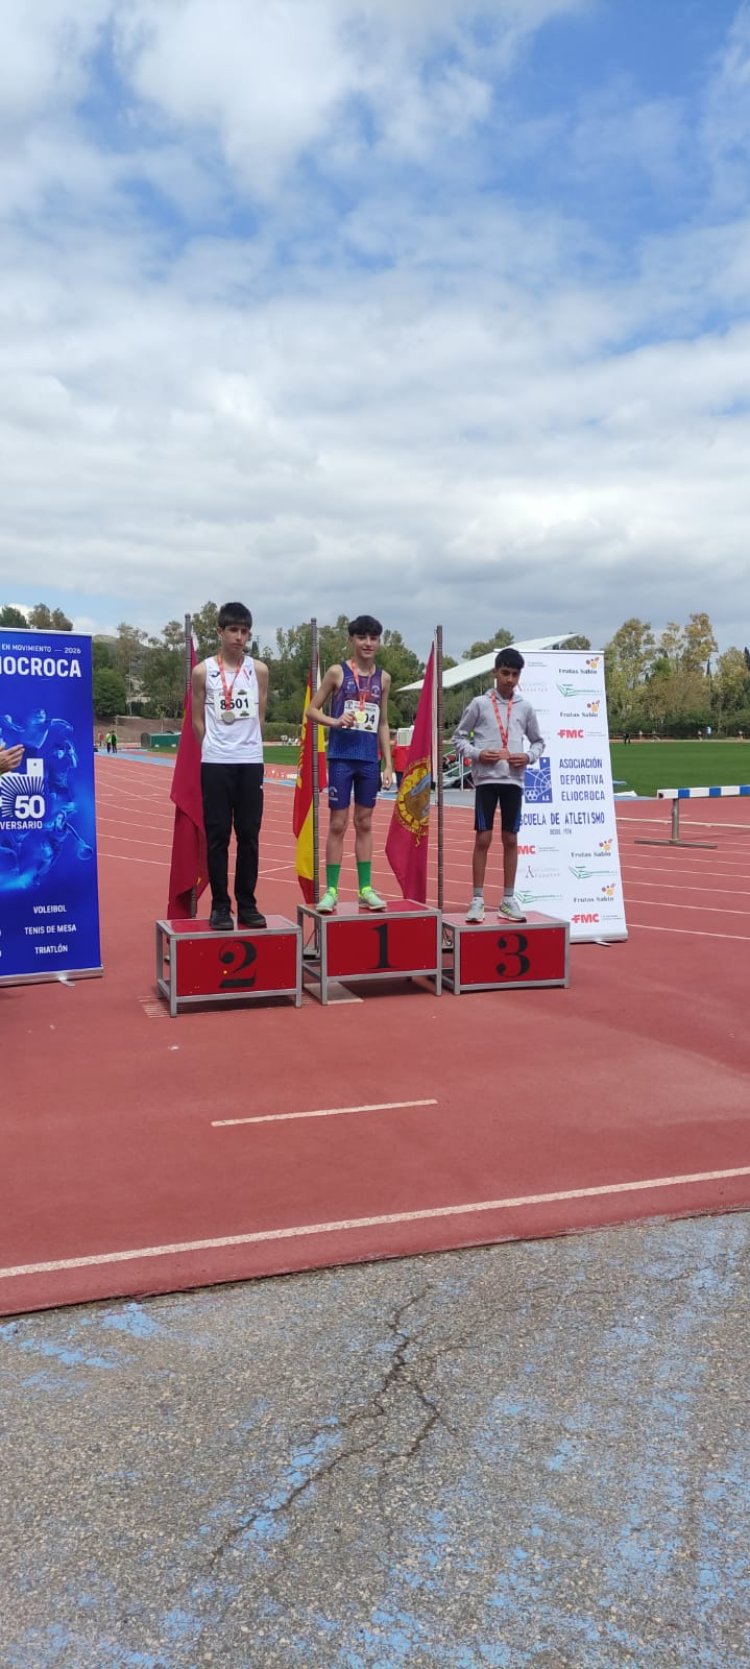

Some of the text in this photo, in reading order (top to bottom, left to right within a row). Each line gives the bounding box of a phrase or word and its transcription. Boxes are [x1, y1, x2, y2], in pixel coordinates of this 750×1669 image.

[1, 643, 11, 651] EN
[12, 644, 52, 653] MOVIMIENTO
[219, 698, 249, 710] 8501
[559, 729, 584, 739] FMC
[559, 756, 603, 769] ASOCIACIÓN
[560, 774, 604, 785] DEPORTIVA
[561, 790, 606, 801] ELIOCROCA
[14, 795, 45, 819] 50
[519, 812, 605, 826] SCUELA DE ATLETISMO
[517, 845, 536, 855] MC
[33, 905, 67, 914] VOLEIBOL
[573, 913, 600, 923] FMC
[25, 924, 77, 935] TENIS DE MESA
[34, 943, 68, 954] TRIATLÓN
[372, 924, 391, 970] 1
[496, 933, 530, 977] 3
[218, 941, 257, 989] 2
